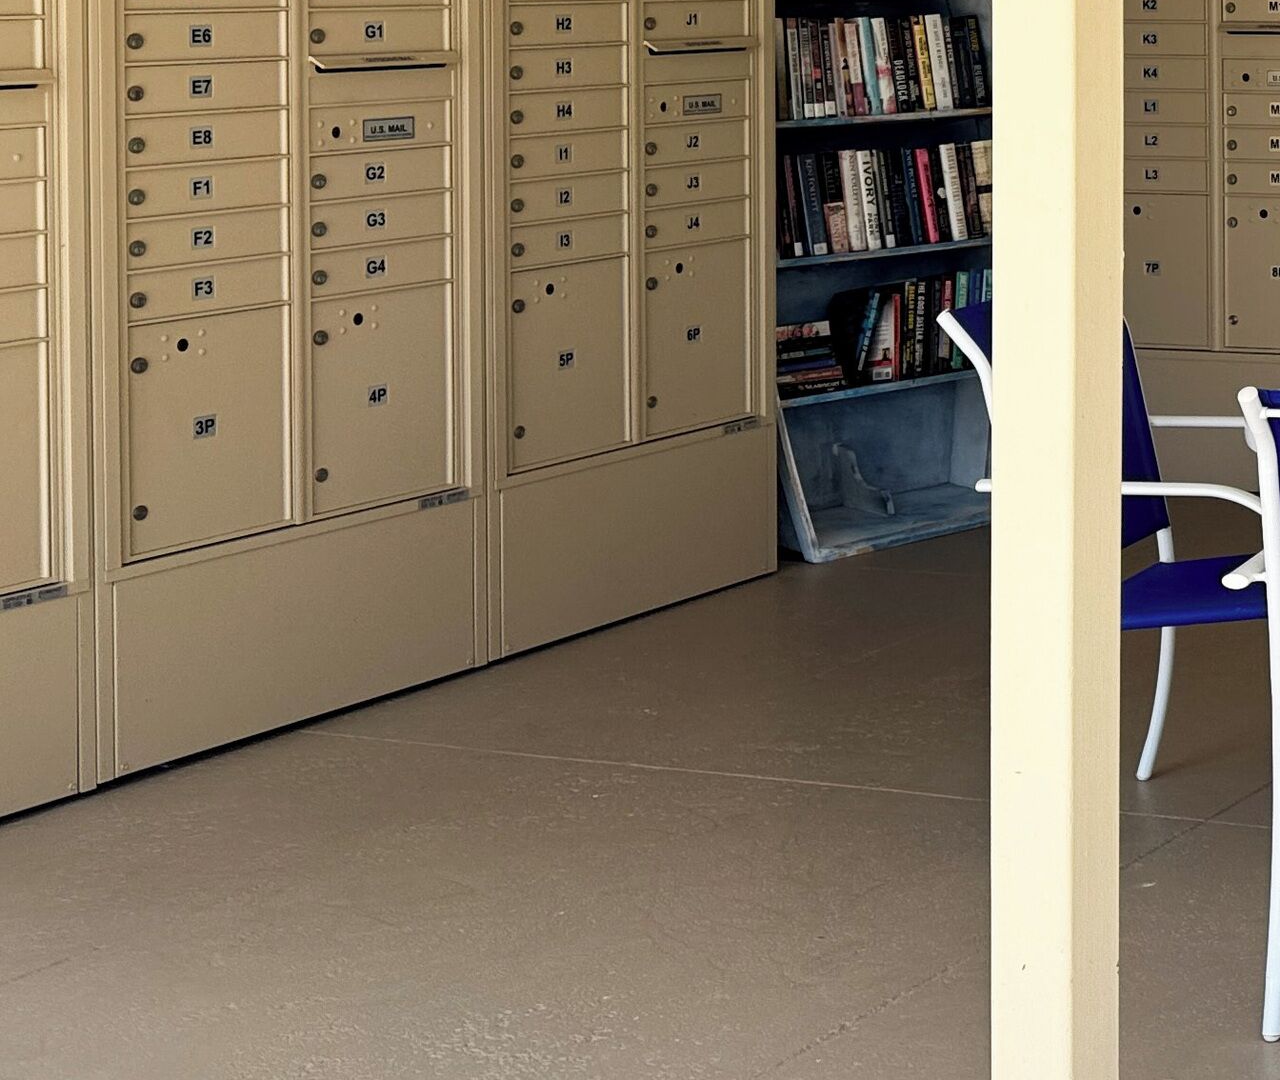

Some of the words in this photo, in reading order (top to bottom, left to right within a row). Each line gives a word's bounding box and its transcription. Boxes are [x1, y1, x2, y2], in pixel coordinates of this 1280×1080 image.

[1142, 0, 1157, 10] K2
[556, 17, 572, 31] H2
[686, 13, 698, 26] J1
[191, 28, 212, 44] E6
[365, 24, 383, 39] G1
[1142, 34, 1157, 45] K3
[556, 61, 572, 75] H3
[1143, 67, 1158, 78] K4
[192, 79, 212, 95] E7
[893, 60, 908, 102] DEADLOCK
[556, 104, 573, 118] H4
[1144, 101, 1156, 113] L1
[192, 129, 212, 145] E8
[686, 135, 699, 149] J2
[1144, 135, 1158, 146] L2
[559, 147, 569, 161] I1
[365, 165, 385, 181] G2
[1145, 169, 1158, 180] L3
[192, 179, 210, 196] F1
[686, 176, 700, 189] J3
[862, 161, 876, 206] IVORY
[559, 190, 570, 204] I2
[366, 212, 386, 228] G3
[687, 216, 700, 230] J4
[867, 212, 875, 236] PARK
[193, 230, 213, 246] F2
[560, 234, 571, 248] I3
[366, 259, 386, 275] G4
[1145, 262, 1159, 273] 7P
[194, 280, 213, 297] F3
[687, 327, 701, 341] 6P
[559, 352, 574, 367] 5P
[368, 387, 387, 404] 4P
[195, 418, 215, 436] 3P
